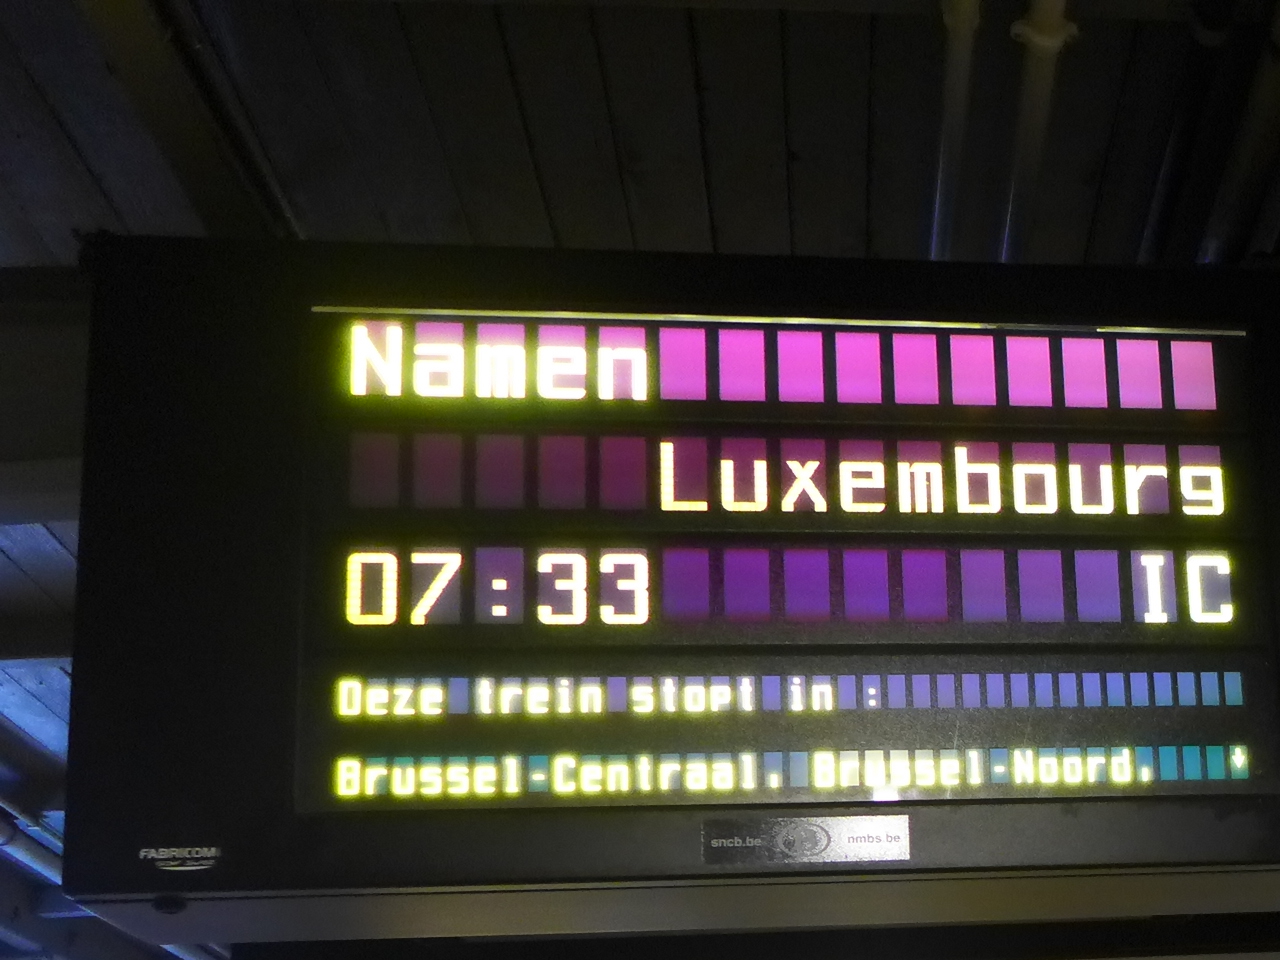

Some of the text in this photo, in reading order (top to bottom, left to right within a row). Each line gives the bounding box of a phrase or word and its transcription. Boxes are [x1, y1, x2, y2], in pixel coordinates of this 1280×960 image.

[349, 324, 648, 401] Namen
[660, 442, 1225, 516] Luxembourg
[346, 552, 1233, 625] 07:33 IC
[338, 679, 444, 716] Deze
[478, 678, 603, 715] trein
[631, 677, 753, 713] stopt
[791, 677, 833, 711] in
[710, 835, 763, 848] sncb.be
